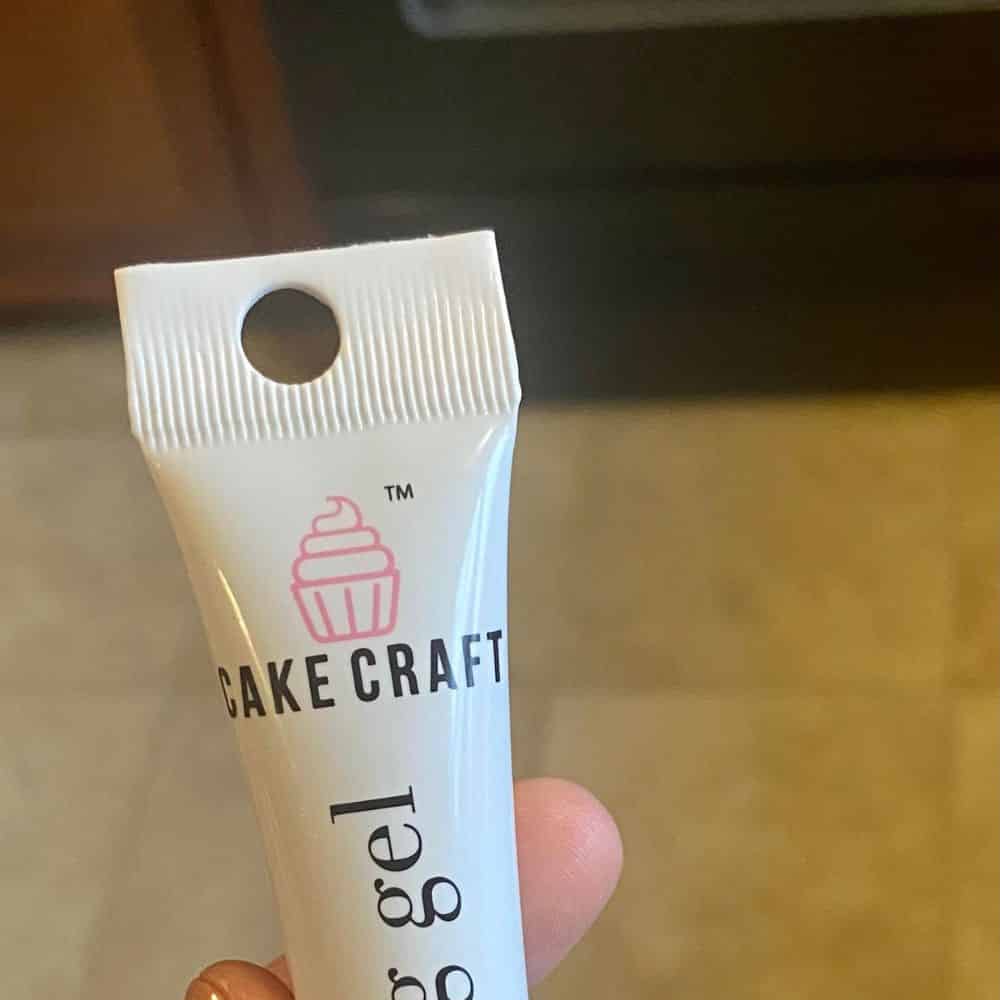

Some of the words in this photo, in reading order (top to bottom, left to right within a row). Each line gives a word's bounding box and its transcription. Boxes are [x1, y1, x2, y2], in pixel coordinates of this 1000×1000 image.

[218, 654, 335, 719] CAKE
[350, 629, 503, 703] CRAFT
[329, 785, 462, 929] gel
